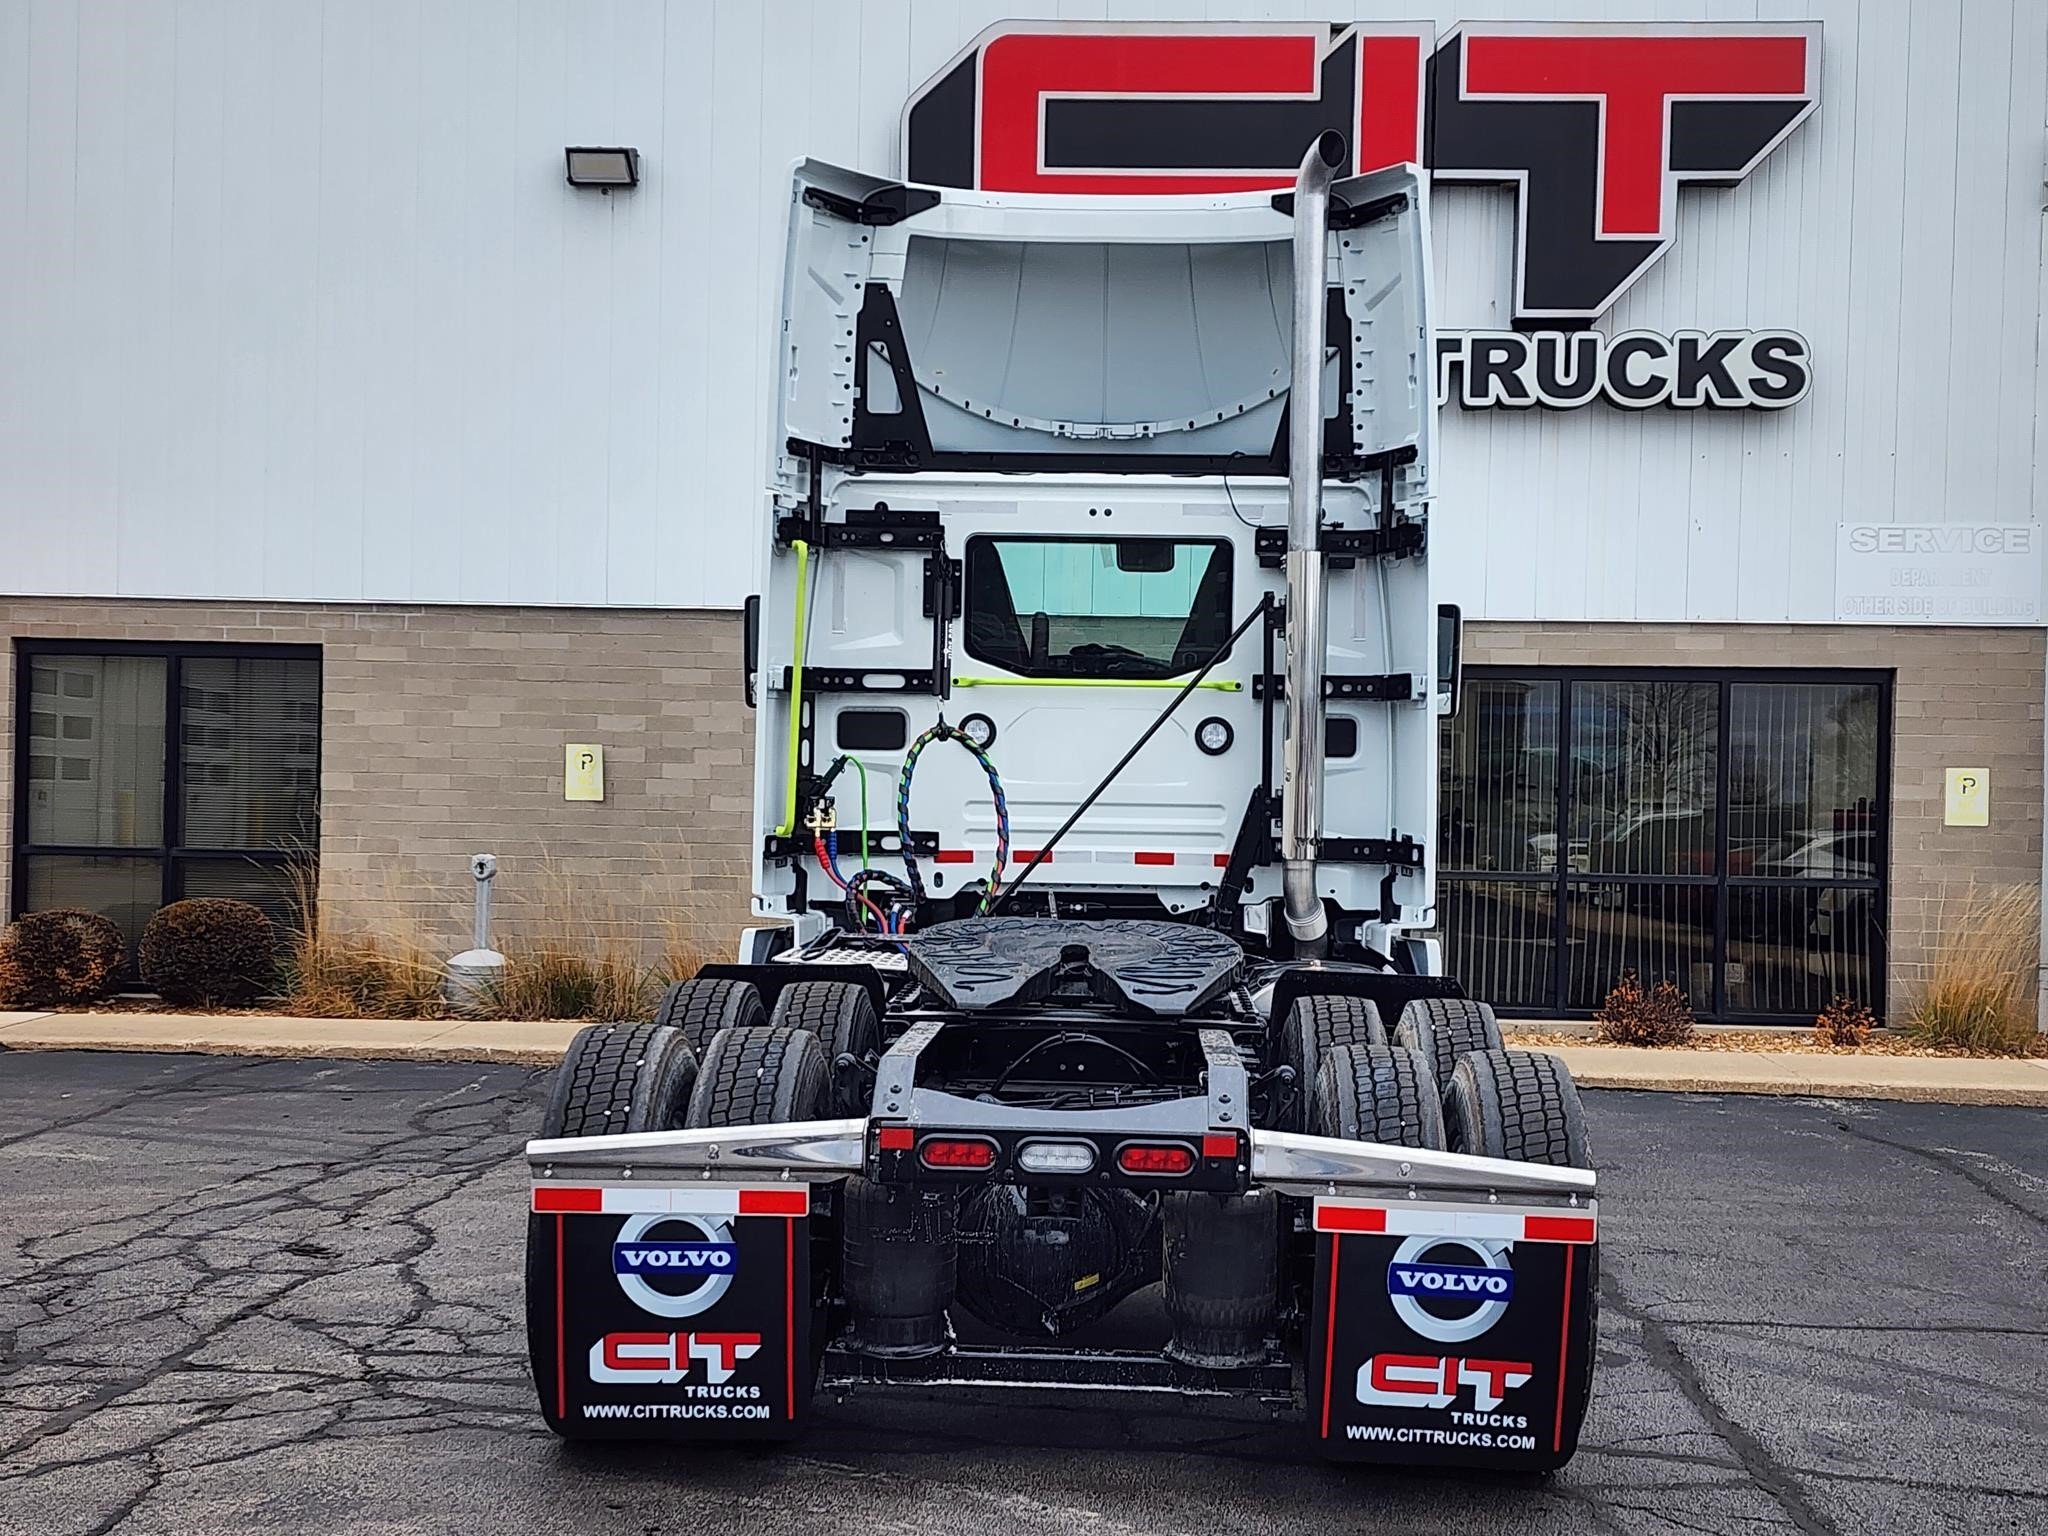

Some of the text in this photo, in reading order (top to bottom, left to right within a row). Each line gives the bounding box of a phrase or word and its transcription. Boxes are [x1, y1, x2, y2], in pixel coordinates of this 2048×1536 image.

[904, 21, 1820, 318] CIT
[1850, 527, 2031, 553] SERVICE
[1890, 567, 1993, 587] DEPARENT
[1843, 596, 1895, 615] OTHER
[1899, 596, 1934, 615] SIDE
[621, 1250, 731, 1267] VOLVO
[1396, 1270, 1508, 1294] VOLVO
[590, 1332, 761, 1384] CIT
[685, 1386, 761, 1398] TRUCKS
[1356, 1354, 1533, 1411] CIT
[583, 1405, 770, 1419] WWW.CITTRUCKS.COM
[1451, 1411, 1528, 1429] TRUCKS
[1346, 1425, 1535, 1450] WWW.CITTRUCKS.COM
